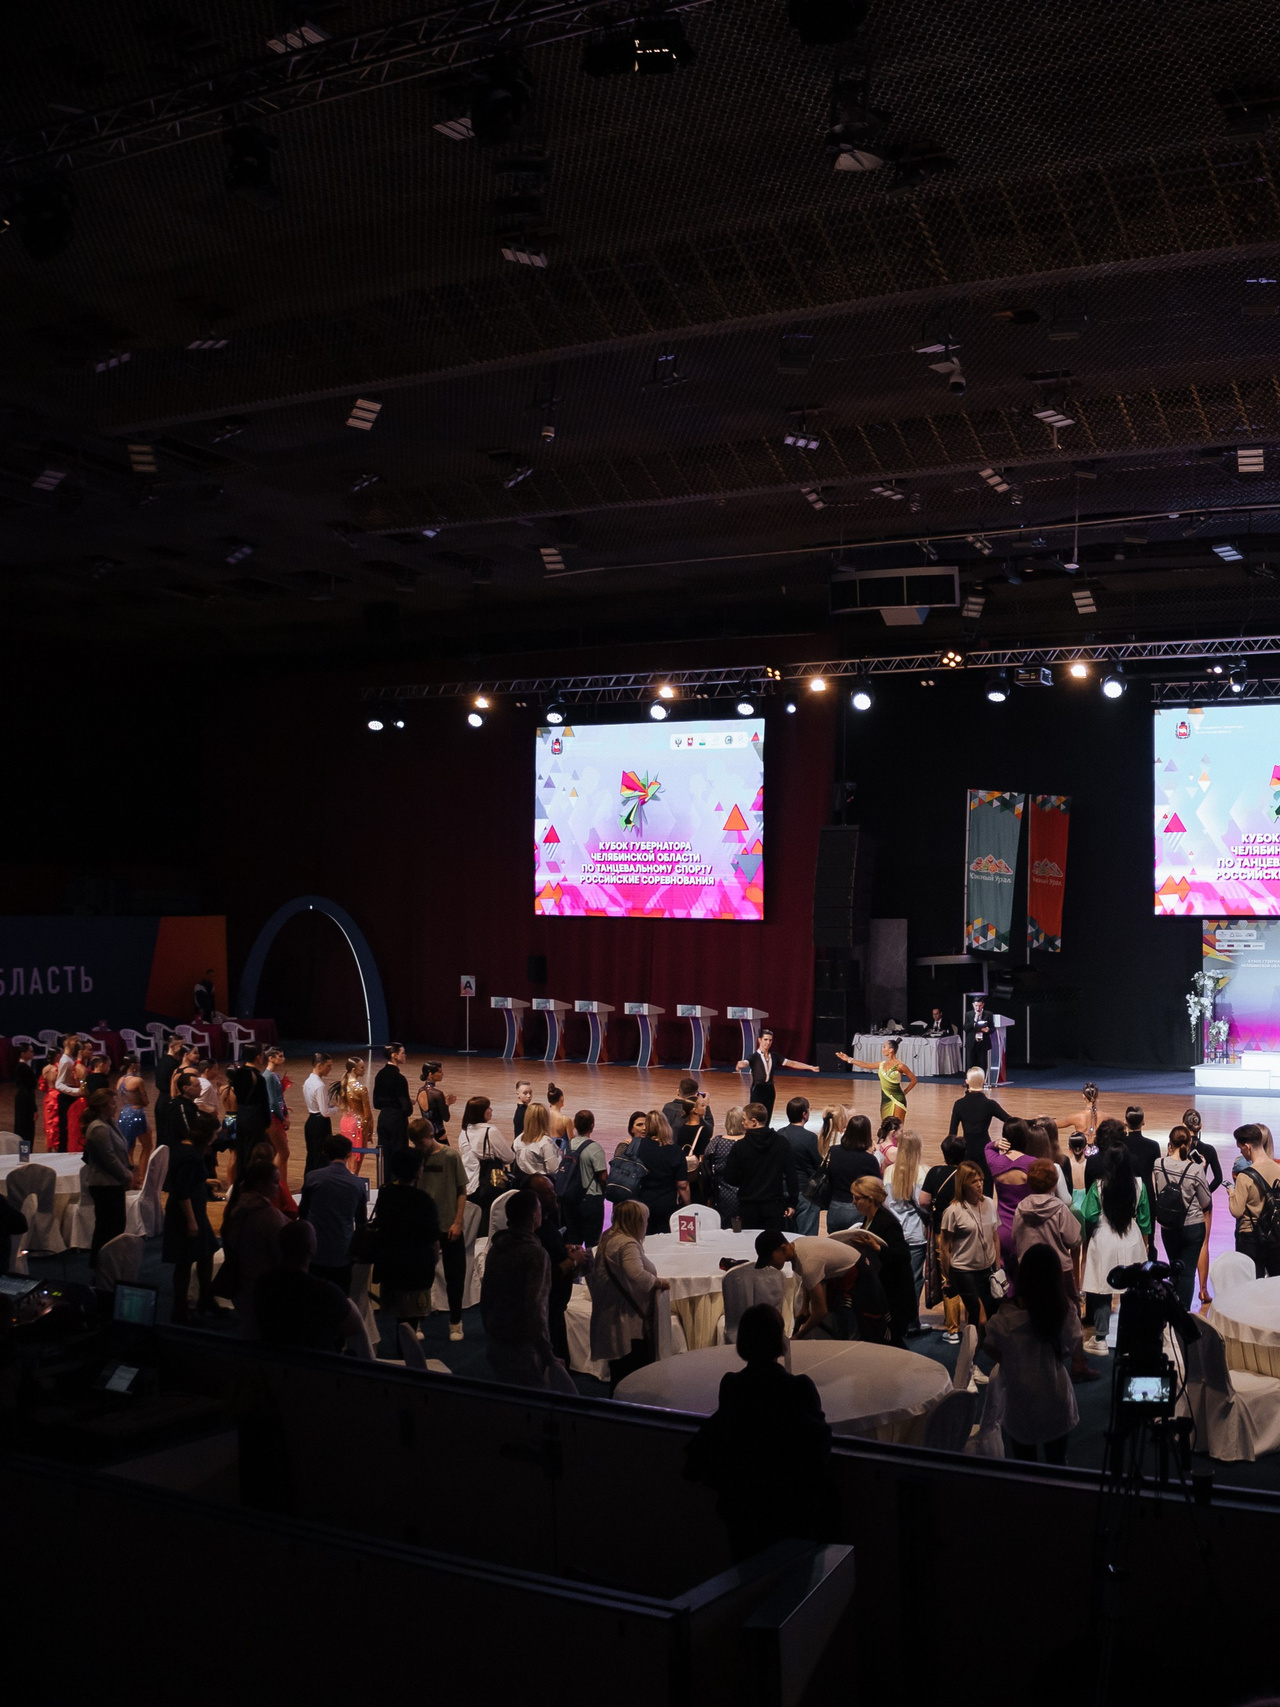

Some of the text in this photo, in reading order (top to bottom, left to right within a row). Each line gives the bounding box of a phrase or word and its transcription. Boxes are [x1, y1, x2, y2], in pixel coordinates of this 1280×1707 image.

[1241, 833, 1280, 843] КУБОК
[599, 842, 692, 851] КУБОК ГУБЕРНАТОРА
[591, 851, 701, 862] ЧЕЛЯБИНСКОЙ ОБЛАСТИ
[1217, 857, 1234, 868] ПО
[581, 864, 712, 875] ПО ТАНЦЕВАЛЬНОМУ СПОРТУ
[580, 874, 715, 886] РОССИЙСКИЕ СОРЕВНОВАНИЯ
[994, 875, 1012, 884] Урал
[463, 981, 473, 991] A
[680, 1220, 694, 1231] 24
